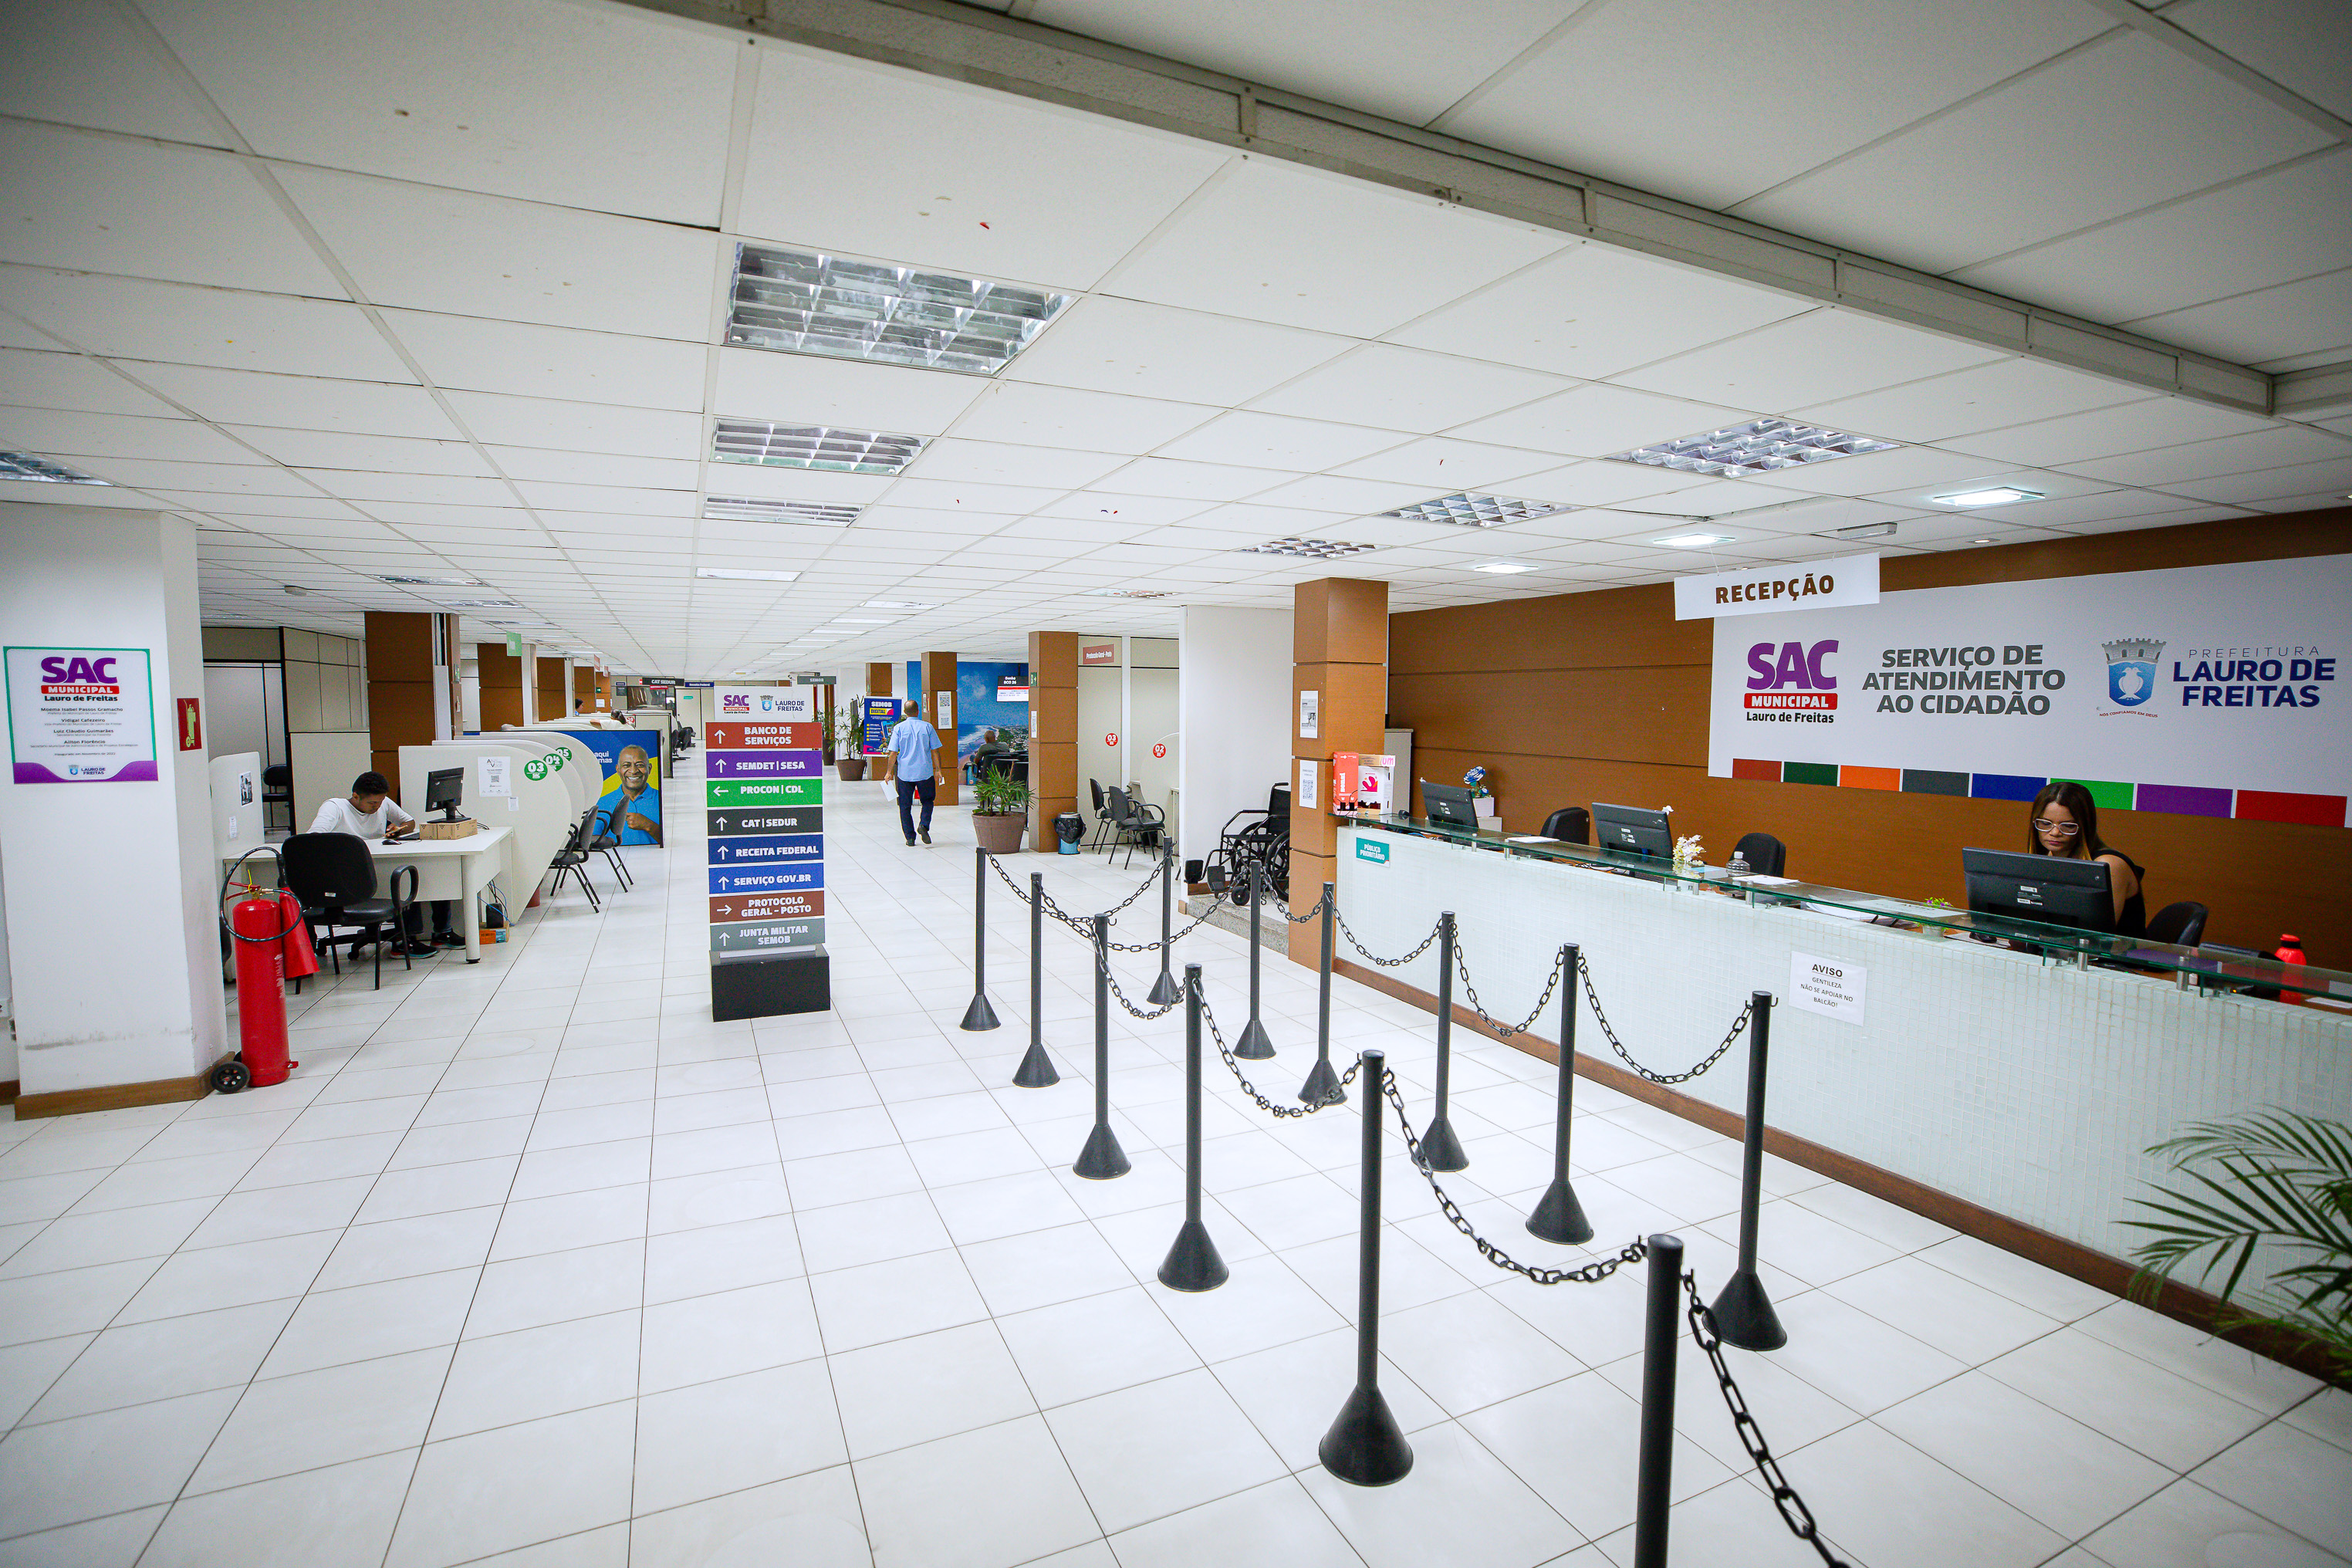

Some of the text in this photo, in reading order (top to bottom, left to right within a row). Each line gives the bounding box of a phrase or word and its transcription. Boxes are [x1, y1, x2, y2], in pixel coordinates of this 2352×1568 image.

[1715, 573, 1835, 604] RECEPÇÃO
[1881, 644, 2043, 671] SERVIÇO DE
[2188, 646, 2320, 658] PREFEITURA
[41, 657, 117, 684] SAC
[1746, 640, 1839, 690] SAC
[2172, 658, 2336, 682] LAURO DE
[1861, 669, 2066, 691] ATENDIMENTO
[724, 694, 749, 706] SAC
[1751, 695, 1829, 708] MUNICIPAL
[2181, 684, 2320, 708] FREITAS
[1877, 691, 2050, 715] AO CIDADÃO
[1746, 711, 1834, 723] Lauro de Freitas
[744, 726, 792, 735] BANCO DE
[745, 736, 792, 746] SERVIÇOS
[546, 755, 560, 764] 04
[736, 762, 775, 770] SEMDET
[781, 761, 805, 770] SESA
[527, 762, 544, 772] 03
[740, 786, 781, 794] PROCON
[786, 785, 804, 794] CDL
[742, 819, 760, 828] CAT
[766, 818, 798, 827] SEDUR
[736, 846, 819, 857] RECEITA FEDERAL
[1364, 843, 1381, 853] PÚBLICO
[734, 874, 811, 886] SERVIÇO GOV.BR
[748, 896, 804, 907] PROTOCOLO
[741, 908, 772, 917] GERAL
[781, 905, 811, 914] POSTO
[740, 926, 808, 938] JUNTA MILITAR
[758, 936, 791, 945] SEMOB
[1812, 964, 1843, 978] AVISO
[1812, 977, 1842, 989] GENTILEZA
[1821, 989, 1842, 999] APOIAR
